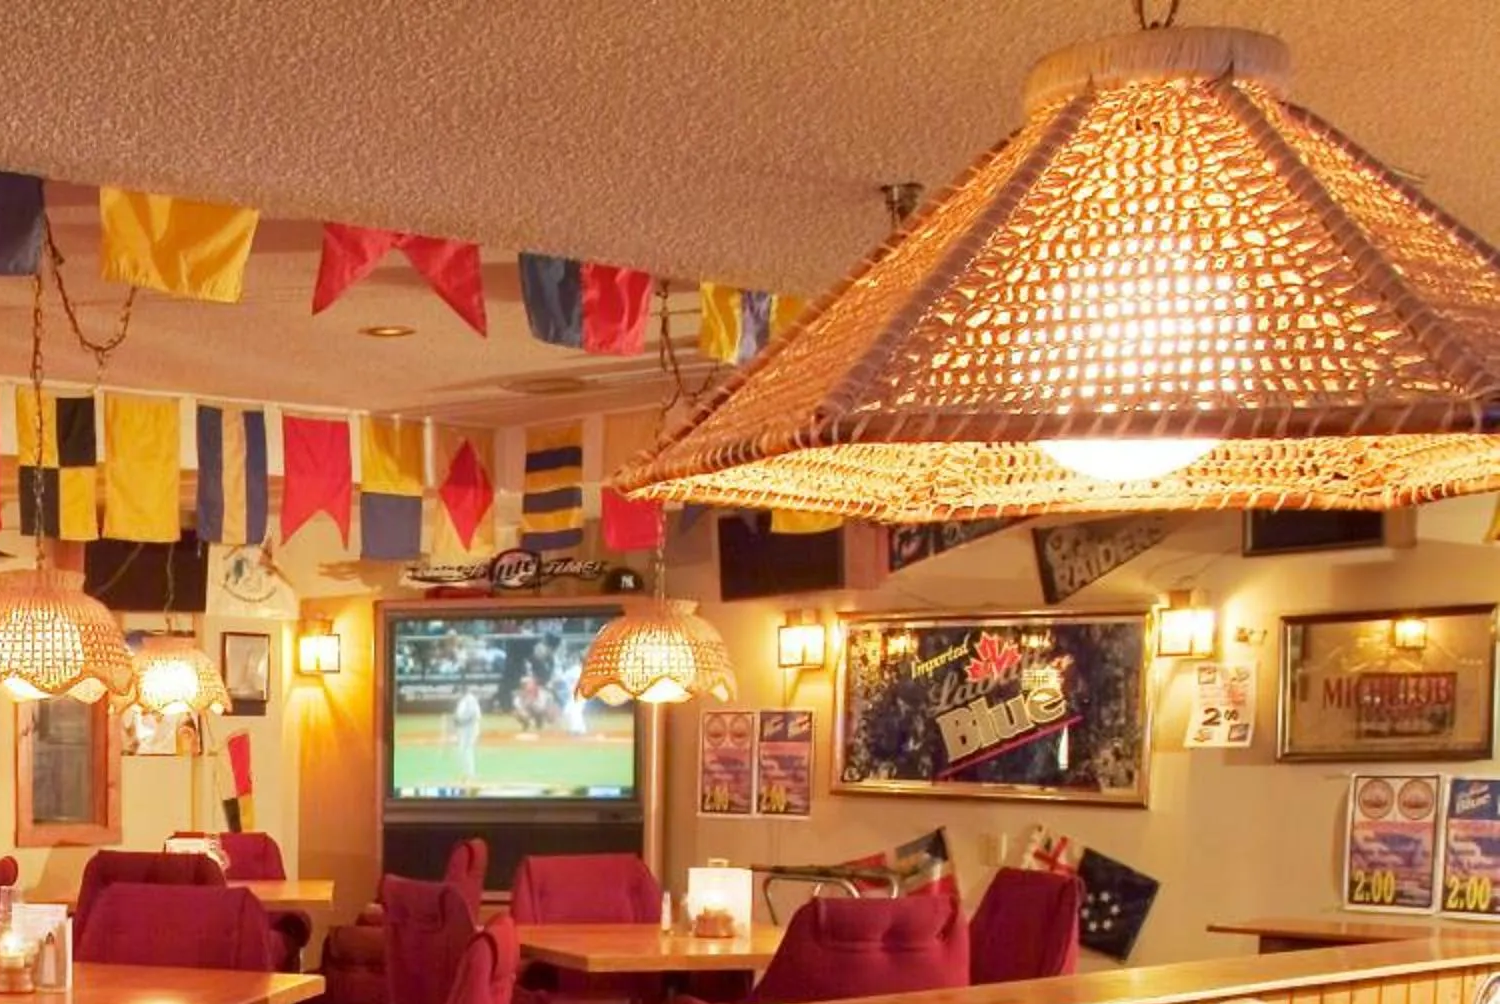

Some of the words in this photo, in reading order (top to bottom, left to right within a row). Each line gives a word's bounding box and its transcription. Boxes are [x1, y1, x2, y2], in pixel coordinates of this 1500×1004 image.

[911, 633, 971, 679] Imported
[936, 687, 1068, 763] Blue
[1353, 869, 1396, 904] 2.00
[1446, 874, 1492, 912] 2.00
